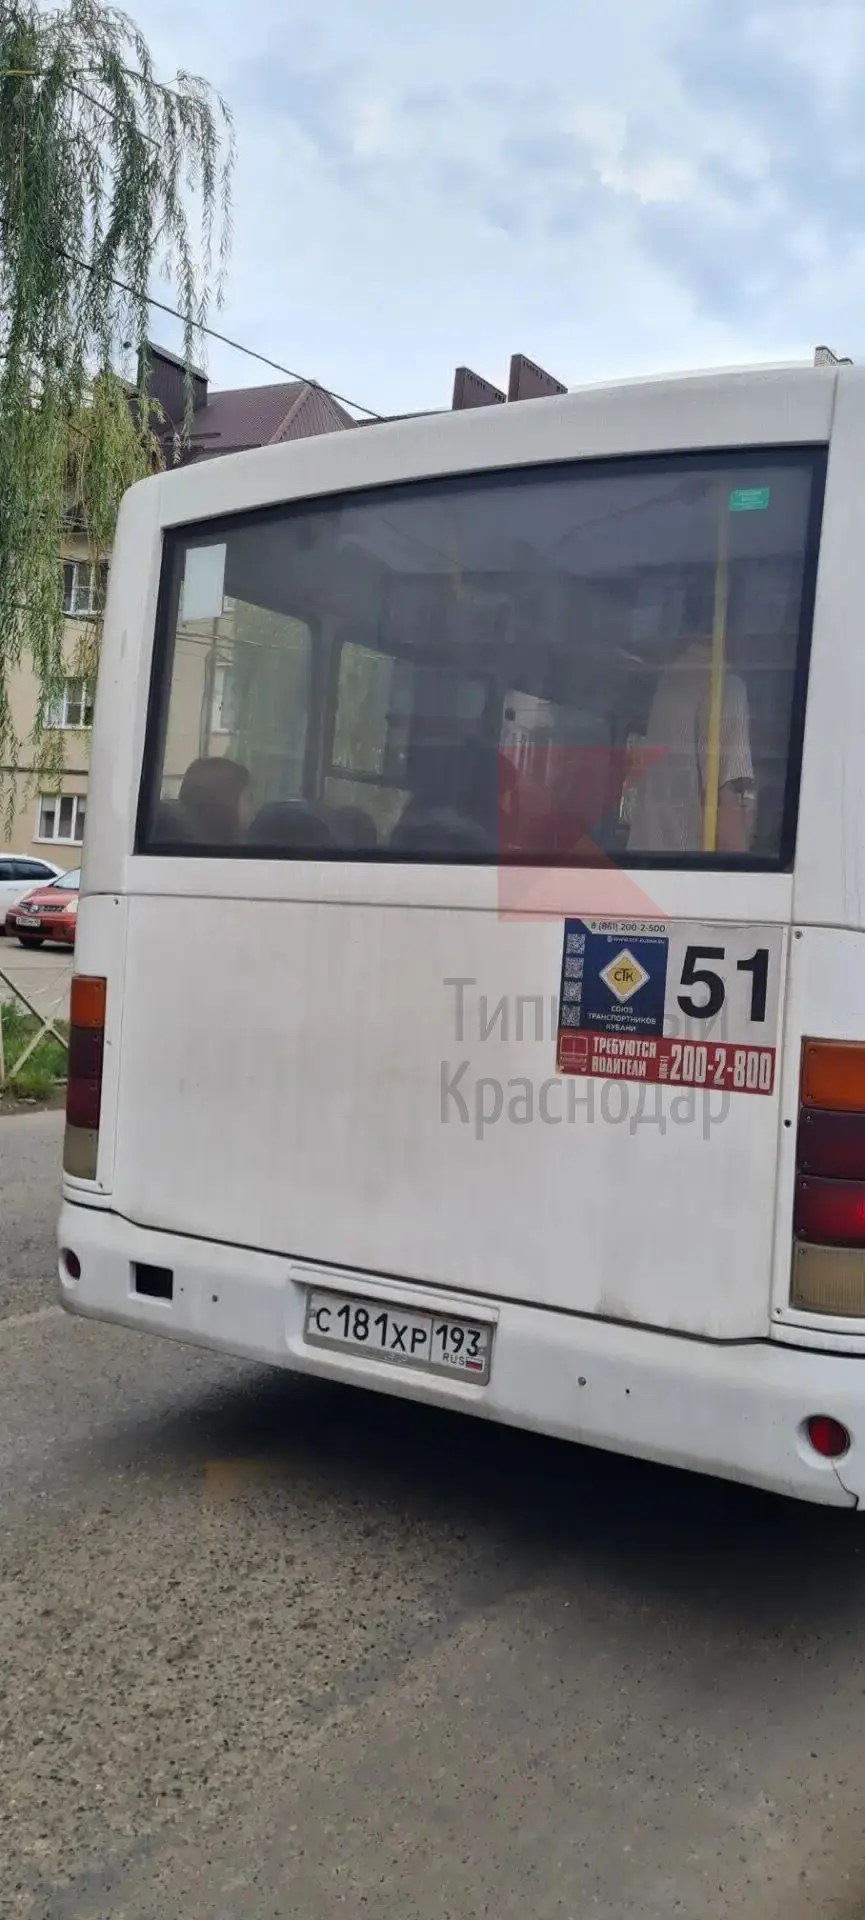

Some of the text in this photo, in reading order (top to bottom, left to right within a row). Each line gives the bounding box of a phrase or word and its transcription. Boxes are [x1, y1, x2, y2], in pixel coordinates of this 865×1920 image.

[598, 921, 618, 932] (861)
[614, 967, 634, 982] СТК
[676, 945, 770, 1023] 51
[611, 1005, 634, 1014] СОЮЗ
[587, 1012, 657, 1025] ТРАНСПОРТНИКОВ
[605, 1023, 637, 1032] КУБАНИ
[593, 1036, 657, 1059] ТРЕБУЮТСЯ
[591, 1055, 647, 1077] ВОДИТЕЛИ
[669, 1043, 773, 1090] 200-2-800
[315, 1304, 482, 1357] С181ХР 193
[442, 1352, 465, 1366] RUS
